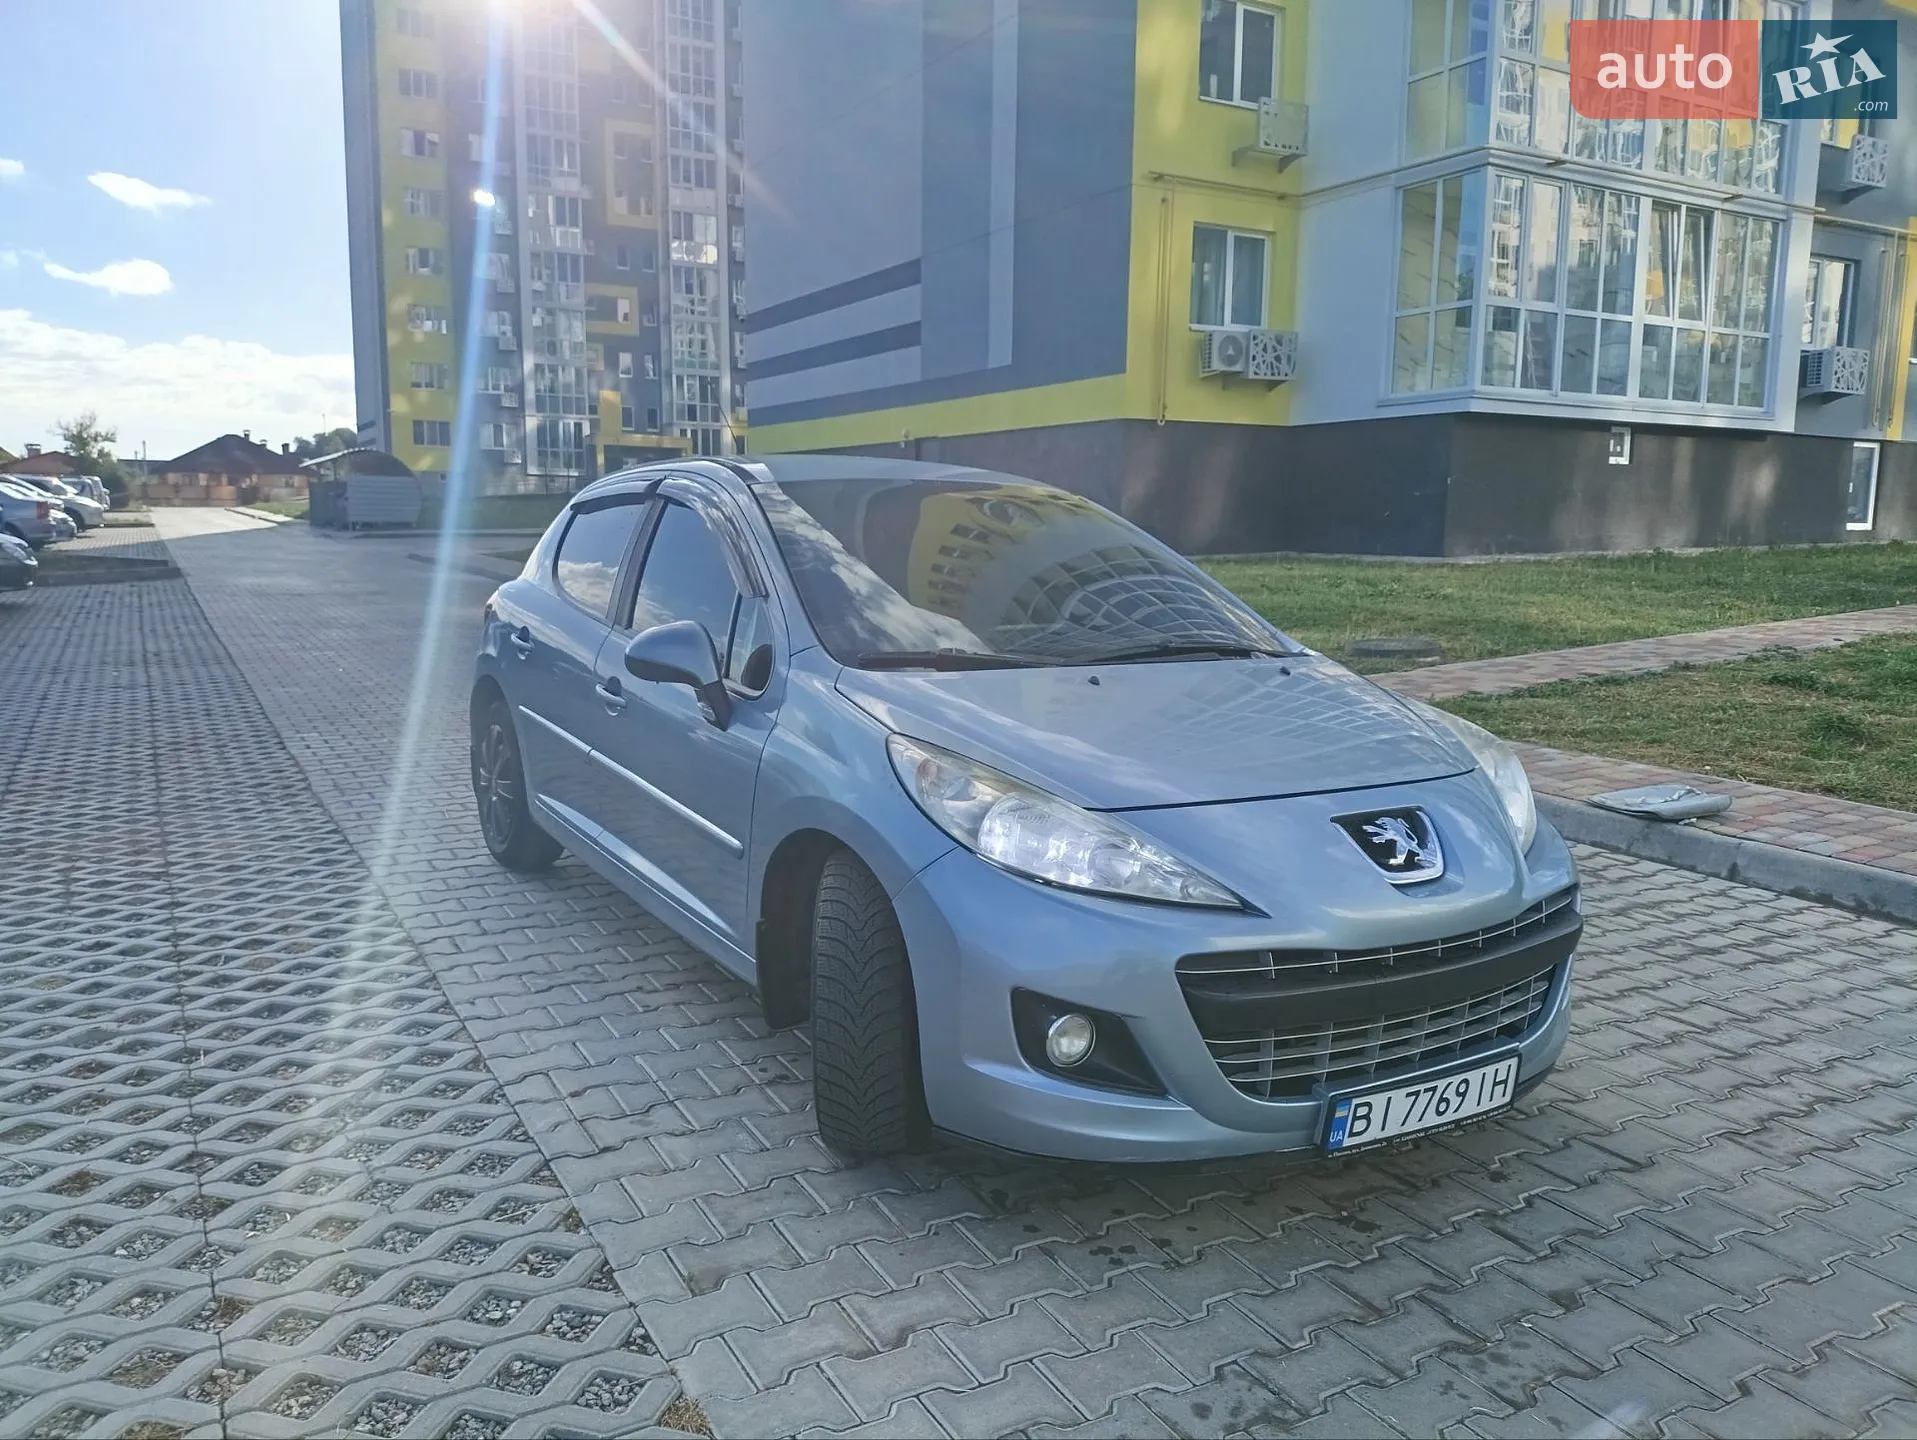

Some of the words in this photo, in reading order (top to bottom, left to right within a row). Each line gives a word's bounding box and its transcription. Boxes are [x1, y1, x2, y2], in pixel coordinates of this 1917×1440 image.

[1347, 1096, 1391, 1138] BI
[1400, 1078, 1470, 1127] 7769
[1477, 1064, 1512, 1107] IH
[1329, 1130, 1343, 1142] UA
